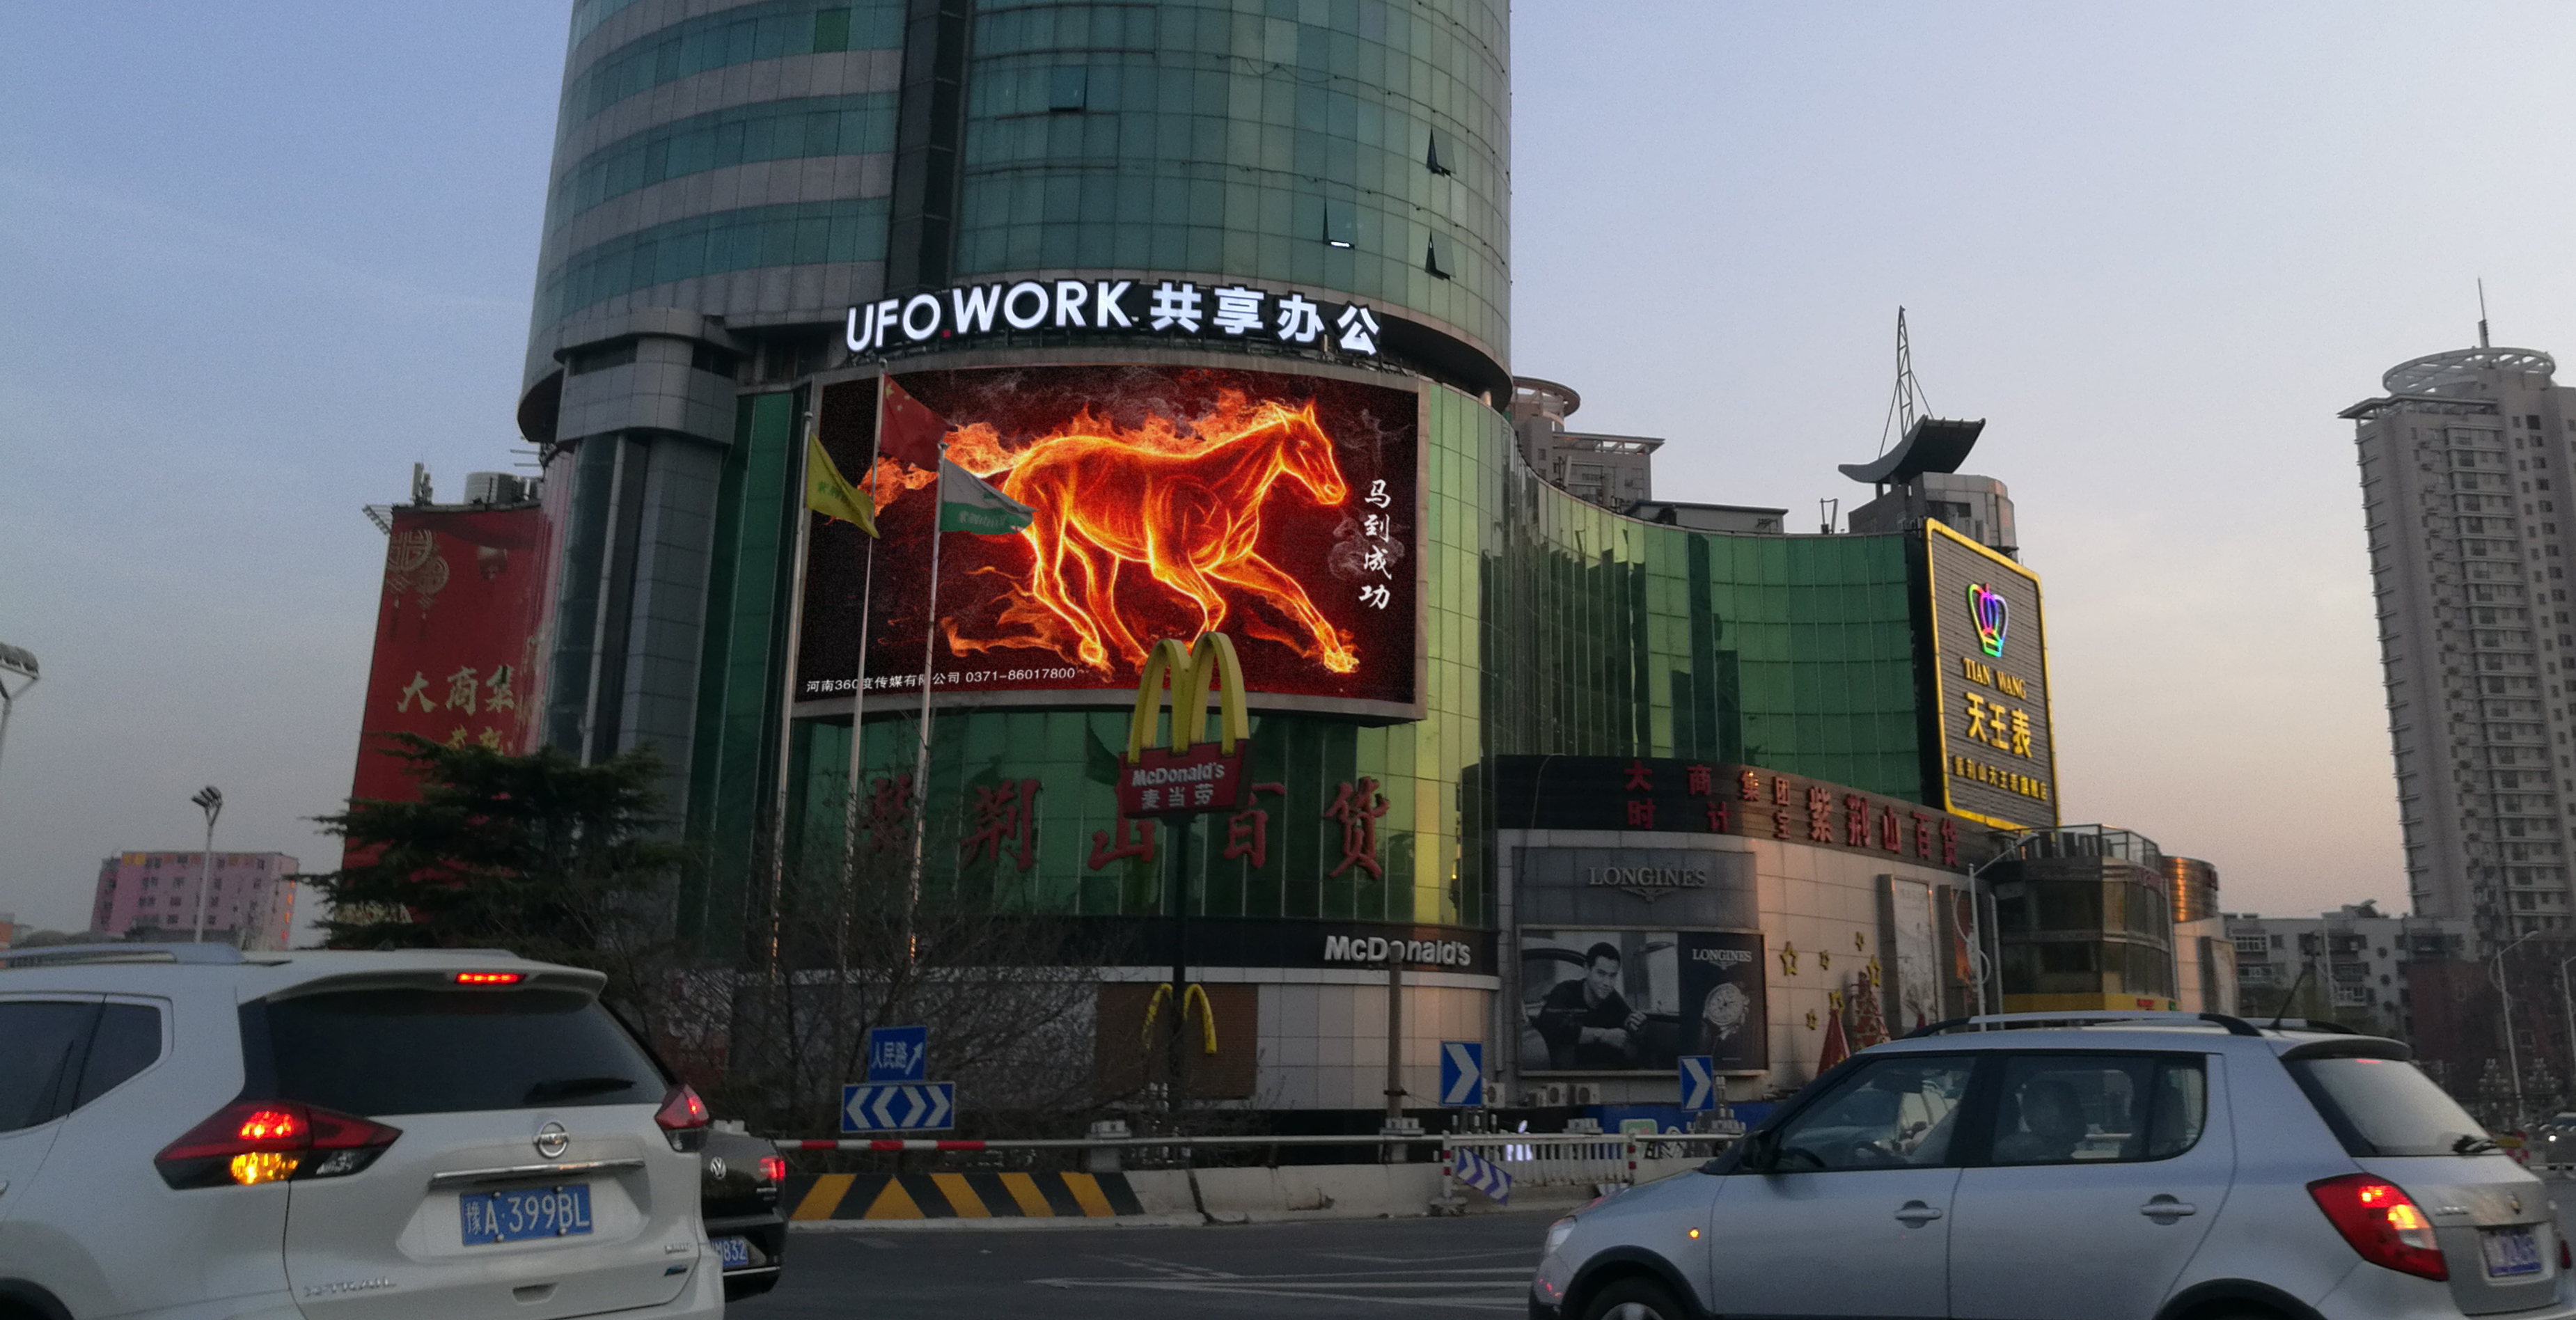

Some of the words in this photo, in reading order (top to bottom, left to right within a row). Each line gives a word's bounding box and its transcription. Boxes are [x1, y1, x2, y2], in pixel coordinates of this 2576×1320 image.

[1150, 281, 1379, 356] 共享办公
[1358, 478, 1392, 611] 马到成功
[966, 667, 1076, 684] 0371-86017800
[1963, 657, 1990, 686] TIAN
[1996, 670, 2027, 700] WANG
[1967, 691, 2032, 758] 天王表
[1132, 763, 1225, 787] McDonald's
[1624, 760, 1791, 806] 大商集团
[1141, 783, 1214, 810] 麦当劳
[1806, 786, 1959, 867] 紫荆山百货
[1588, 867, 1706, 887] LONGINES
[1324, 935, 1471, 966] McDonald's
[1692, 948, 1752, 963] LONGINES
[871, 1041, 908, 1069] 人民路
[711, 1239, 748, 1262] M832
